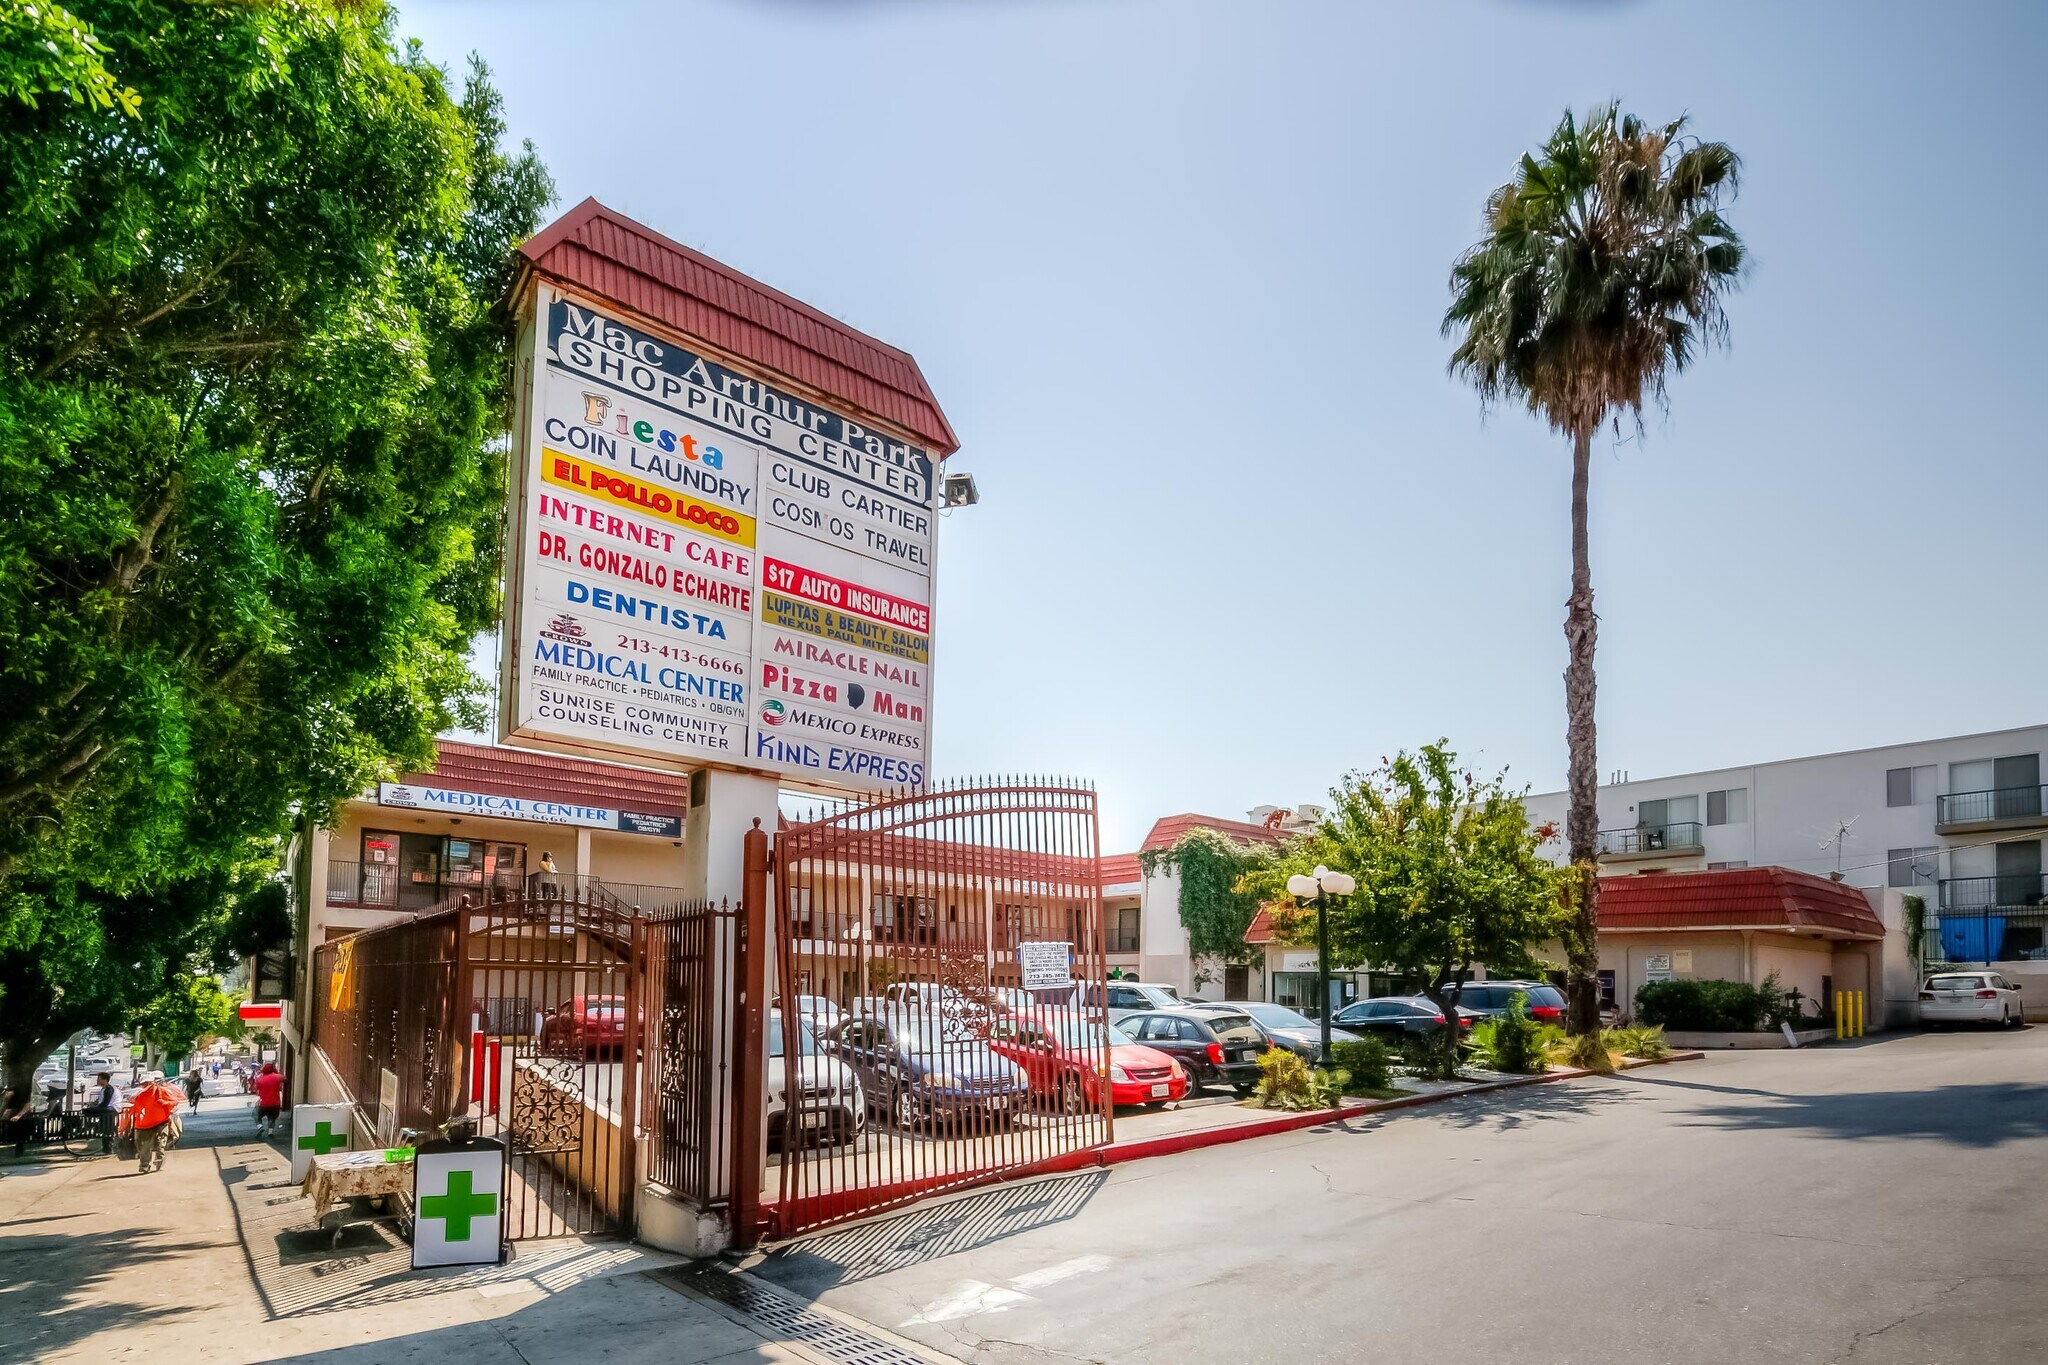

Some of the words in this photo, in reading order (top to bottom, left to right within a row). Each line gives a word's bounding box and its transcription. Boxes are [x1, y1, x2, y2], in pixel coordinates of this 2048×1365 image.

[562, 302, 664, 367] Mac
[681, 358, 828, 434] Arthur
[839, 419, 923, 474] Park
[570, 341, 772, 439] SHOPPING
[799, 433, 919, 497] CENTER
[581, 390, 724, 471] Fiesta
[545, 417, 616, 461] COIN
[631, 446, 751, 505] LAUNDRY
[554, 458, 586, 487] EL
[591, 470, 673, 513] POLLO
[676, 500, 740, 535] LOCO
[772, 463, 830, 499] CLUB
[841, 489, 928, 536] CARTIER
[539, 494, 675, 553] INTERNET
[686, 541, 750, 576] CAFE
[864, 529, 928, 567] TRAVEL
[539, 531, 572, 562] DR.
[579, 543, 667, 588] GONZALO
[673, 569, 750, 612] ECHARTE
[768, 563, 795, 588] $17
[800, 574, 841, 604] AUTO
[847, 588, 927, 630] INSURANCE
[567, 580, 727, 640] DENTISTA
[766, 595, 819, 623] LUPITAS
[825, 612, 833, 626] &
[839, 616, 888, 641] BEAUTY
[891, 630, 929, 653] SALON
[543, 632, 589, 647] CROWN
[617, 635, 744, 675] 213-413-6666
[773, 636, 868, 675] MIRACLE
[874, 661, 920, 688] NAIL
[778, 616, 822, 634] NEXUS
[827, 629, 857, 644] PAUL
[862, 637, 919, 660] MITCHELL
[533, 665, 573, 682] FAMILY
[575, 674, 628, 695] PRACTICE
[640, 688, 697, 708] PEDIATRICS
[709, 702, 745, 718] OB/GYN
[534, 639, 652, 685] MEDICAL
[658, 668, 744, 704] CENTER
[763, 663, 837, 703] Pizza
[873, 690, 923, 723] Man
[538, 705, 654, 736] COUNSELING
[663, 728, 730, 750] CENTER
[539, 689, 616, 714] SUNRISE
[626, 706, 729, 735] COMMUNITY
[789, 709, 856, 735] MEXICO
[860, 724, 920, 750] EXPRESS
[757, 730, 820, 768] KING
[828, 747, 923, 785] EXPRESS
[424, 789, 525, 812] MEDICAL
[532, 802, 609, 821] CENTER
[468, 806, 568, 823] 213-413-6666
[623, 812, 646, 820] FAMILY
[645, 815, 675, 824] PRACTICE
[632, 819, 667, 829] PEDIATRICS
